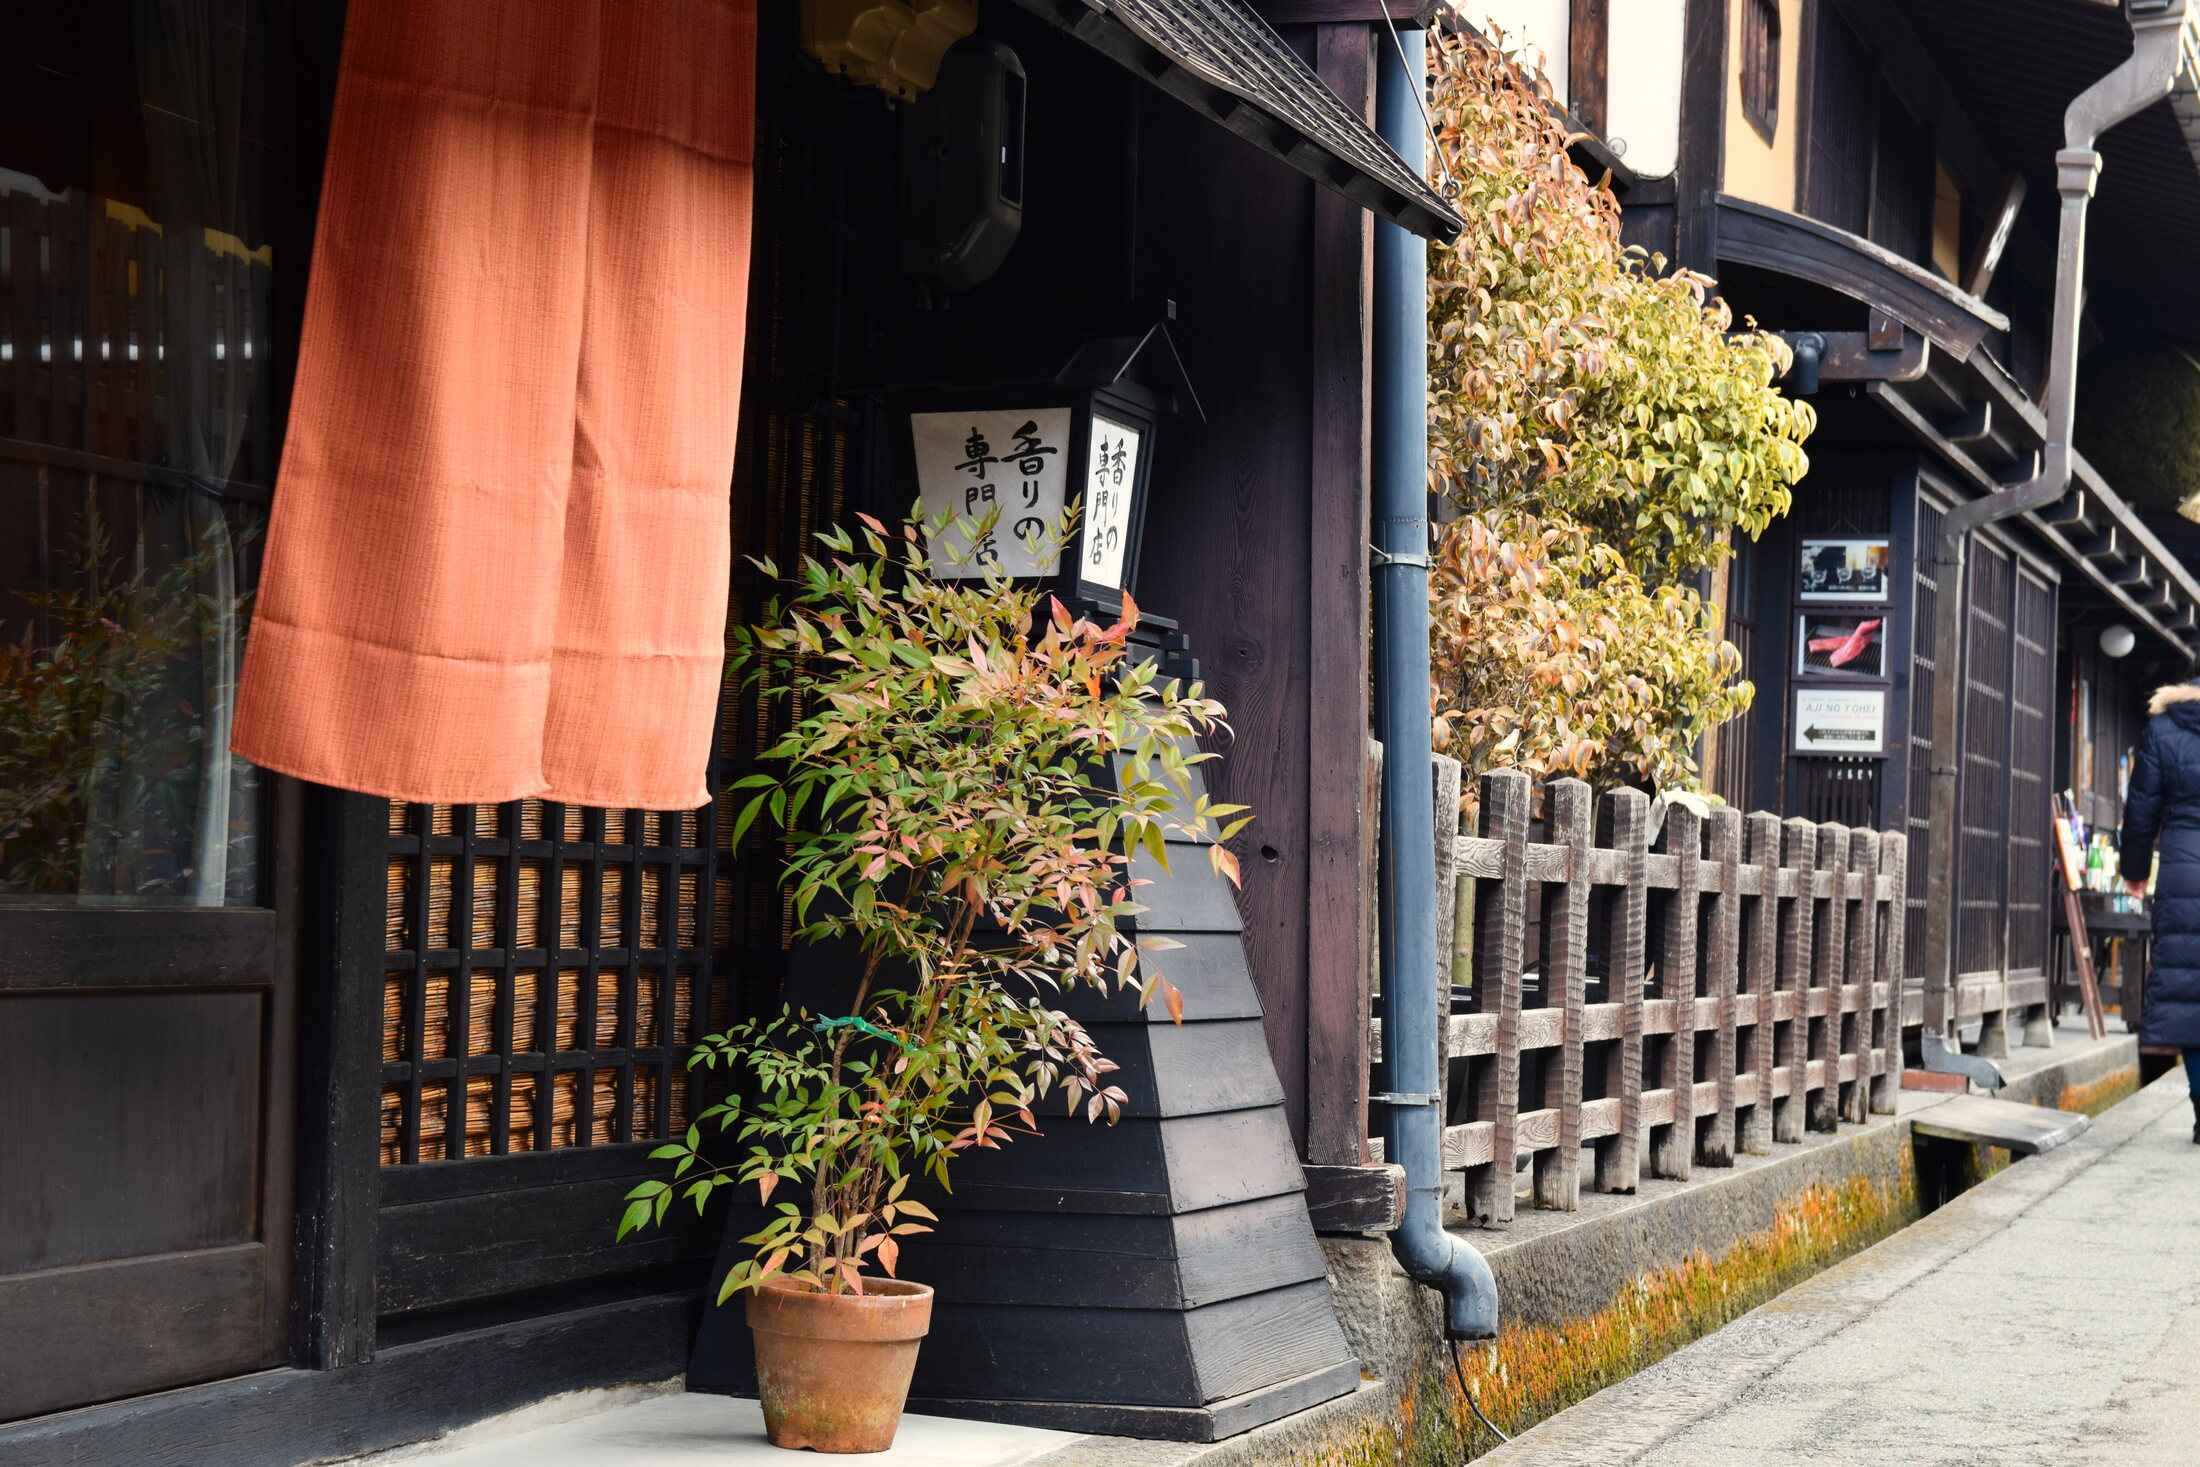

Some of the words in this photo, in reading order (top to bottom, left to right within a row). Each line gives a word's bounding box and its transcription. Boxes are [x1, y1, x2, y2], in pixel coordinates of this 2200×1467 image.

[1001, 420, 1058, 541] 香りの
[1089, 433, 1109, 566] 専門店
[1105, 437, 1127, 552] 香りの
[1806, 703, 1822, 712] AJI
[1826, 703, 1840, 712] NO
[1845, 703, 1876, 713] YOHEI
